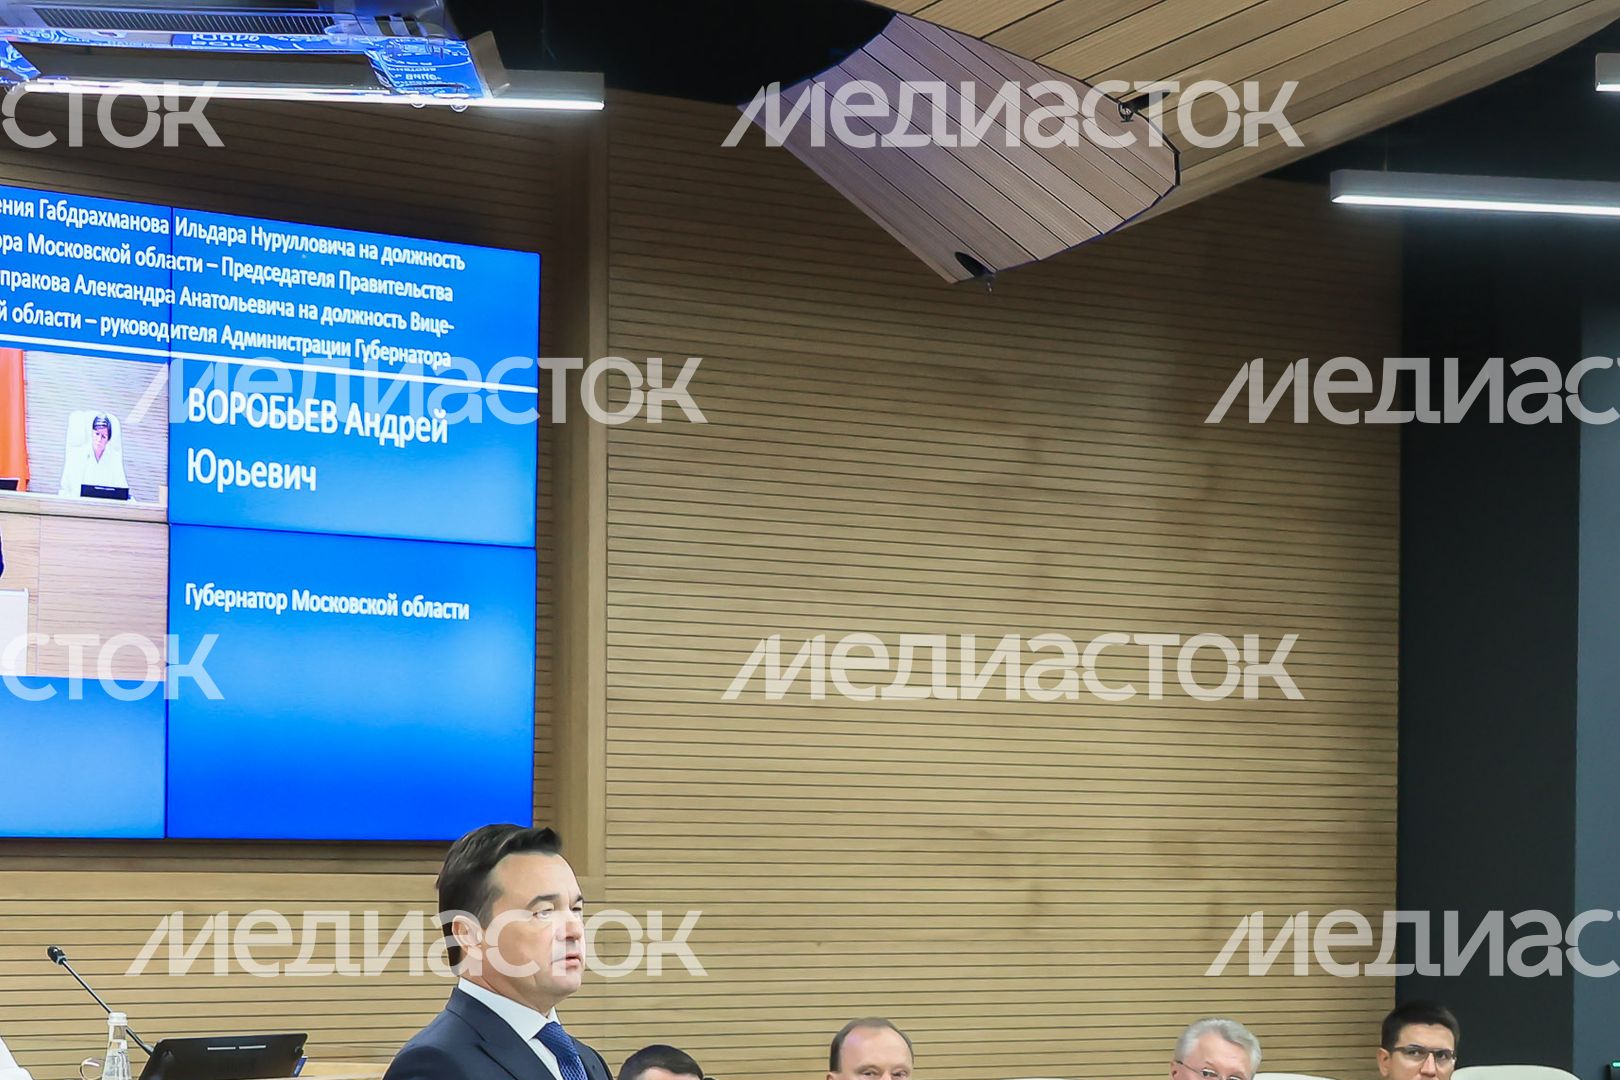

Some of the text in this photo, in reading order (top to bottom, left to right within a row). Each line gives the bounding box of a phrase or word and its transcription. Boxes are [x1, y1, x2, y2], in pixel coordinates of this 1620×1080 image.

[0, 198, 466, 270] ния Габдрахманова Ильдара Нурулловича на должность
[0, 234, 23, 255] ра
[27, 232, 131, 265] Московской
[135, 246, 203, 273] области
[221, 256, 336, 288] Председателя
[339, 270, 453, 302] Правительства
[12, 302, 82, 329] области
[100, 316, 217, 345] руководителя
[221, 324, 351, 359] Администрации
[355, 338, 452, 370] Губернатора
[74, 274, 176, 307] Александра
[179, 286, 295, 317] Анатольевича
[299, 303, 318, 320] на
[320, 306, 408, 330] должность
[410, 311, 455, 337] Вице-
[188, 387, 448, 448] ВОРОБЬЕВ Андрей
[187, 447, 317, 493] Юрьевич
[185, 583, 470, 620] Губернатор Московской области
